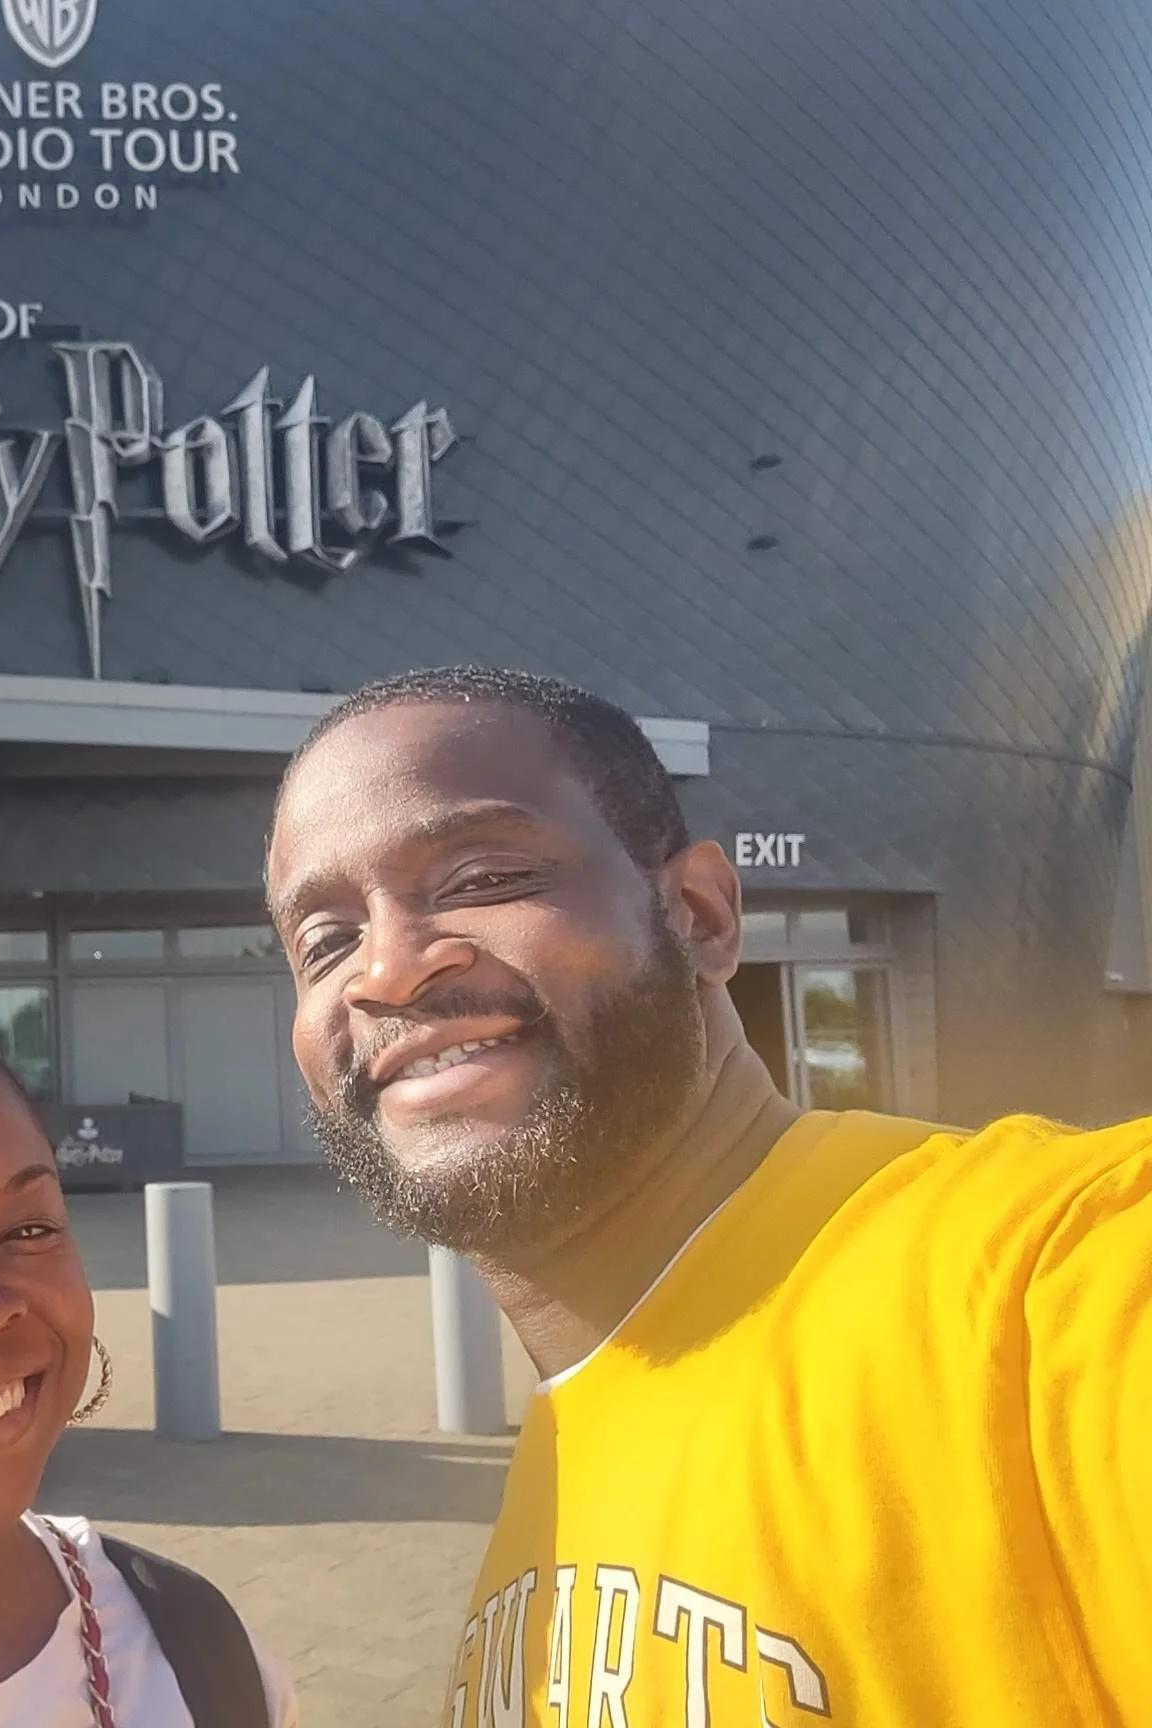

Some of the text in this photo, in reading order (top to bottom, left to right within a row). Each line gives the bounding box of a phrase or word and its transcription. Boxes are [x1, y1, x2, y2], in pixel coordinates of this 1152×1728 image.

[101, 82, 239, 122] BROS.
[89, 128, 241, 174] TOUR
[51, 341, 457, 680] Potter
[735, 832, 806, 867] EXIT
